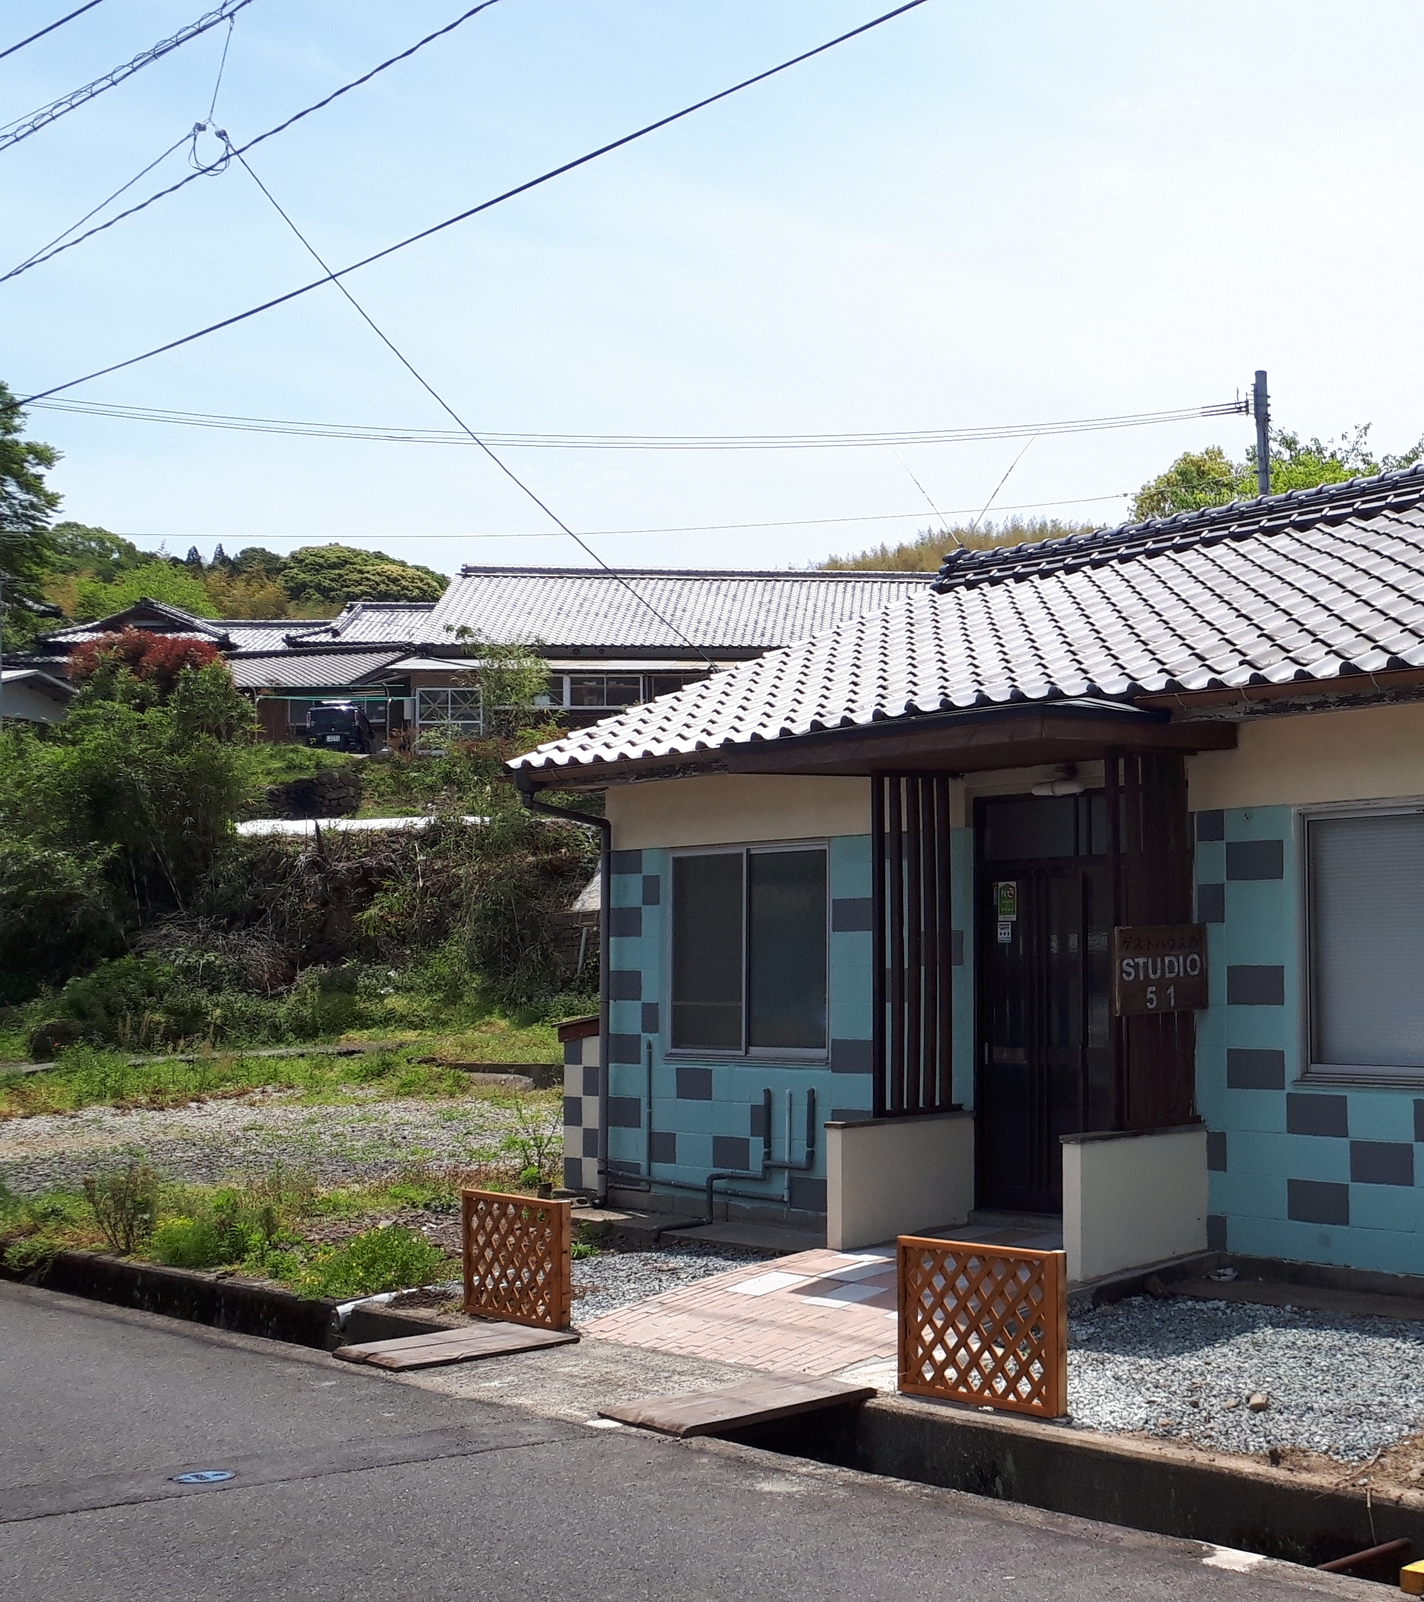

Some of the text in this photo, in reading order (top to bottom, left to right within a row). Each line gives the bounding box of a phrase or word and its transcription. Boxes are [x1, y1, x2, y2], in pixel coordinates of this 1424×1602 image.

[1122, 936, 1198, 951] ゲストハウスの
[1121, 953, 1202, 981] STUDIO
